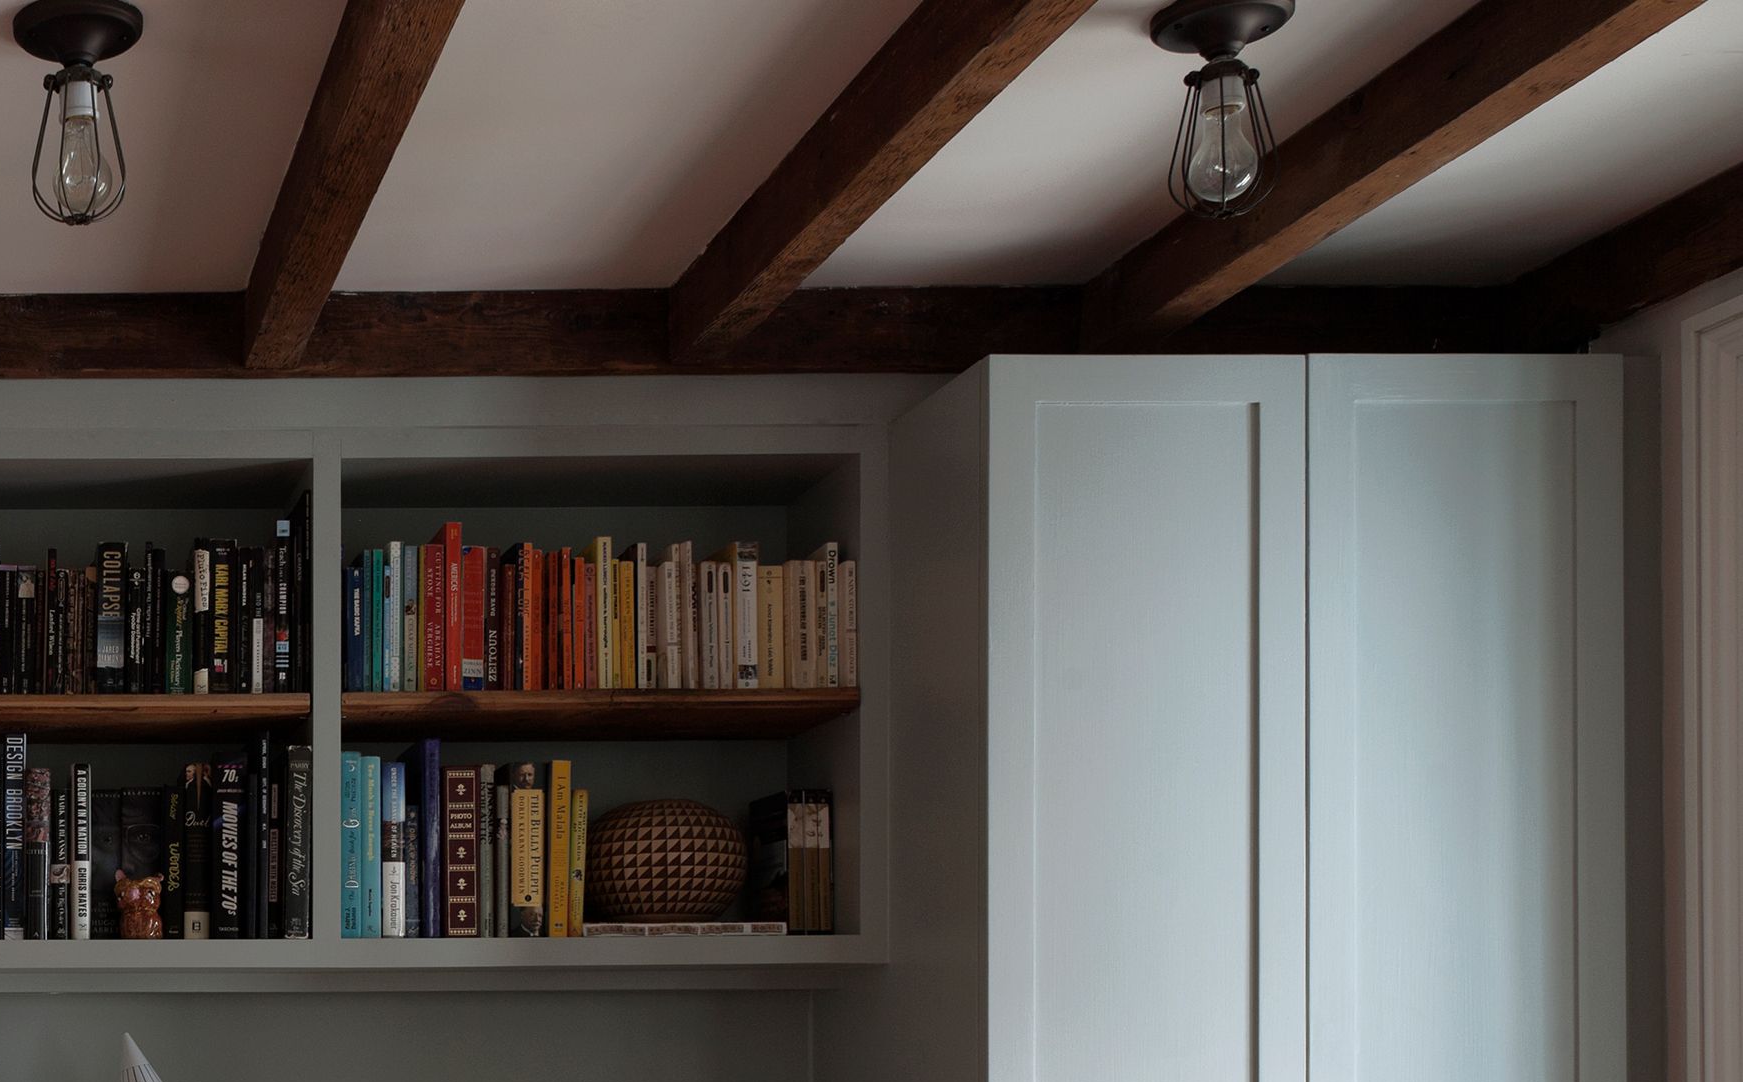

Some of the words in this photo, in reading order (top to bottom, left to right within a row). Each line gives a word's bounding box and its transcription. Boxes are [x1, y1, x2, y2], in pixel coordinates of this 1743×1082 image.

[102, 550, 121, 618] COLLAPSE
[450, 562, 459, 592] AMERICAS
[353, 616, 361, 636] KAFKA
[488, 629, 498, 683] ZEITOUN
[5, 736, 24, 781] DESIGN
[76, 776, 87, 808] COLONY
[292, 771, 307, 793] The
[367, 778, 375, 802] Much
[479, 781, 486, 791] IN
[556, 784, 566, 802] Am
[57, 794, 66, 816] MARK
[76, 809, 87, 817] IN
[486, 781, 496, 846] DINOSAURS
[518, 796, 526, 820] DORIS
[530, 795, 540, 817] THE
[5, 788, 24, 850] BROOKLYN
[221, 801, 238, 850] MOVIES
[290, 793, 306, 846] Discovery
[448, 822, 472, 830] ALBUM
[556, 805, 566, 840] Malala
[57, 818, 66, 862] KURLANSKY
[76, 825, 87, 855] NATION
[518, 822, 526, 854] KEARNS
[530, 819, 541, 854] BULLY
[221, 851, 237, 867] OF
[291, 847, 307, 860] of
[292, 855, 307, 870] the
[77, 867, 87, 892] CHRIS
[221, 869, 237, 892] THE
[288, 871, 306, 896] Sea
[389, 880, 400, 895] Jon
[518, 855, 526, 895] GOODWIN
[529, 855, 540, 895] PULPIT
[77, 892, 87, 918] HAYES
[221, 892, 237, 916] 70s
[389, 894, 399, 930] Krakauer
